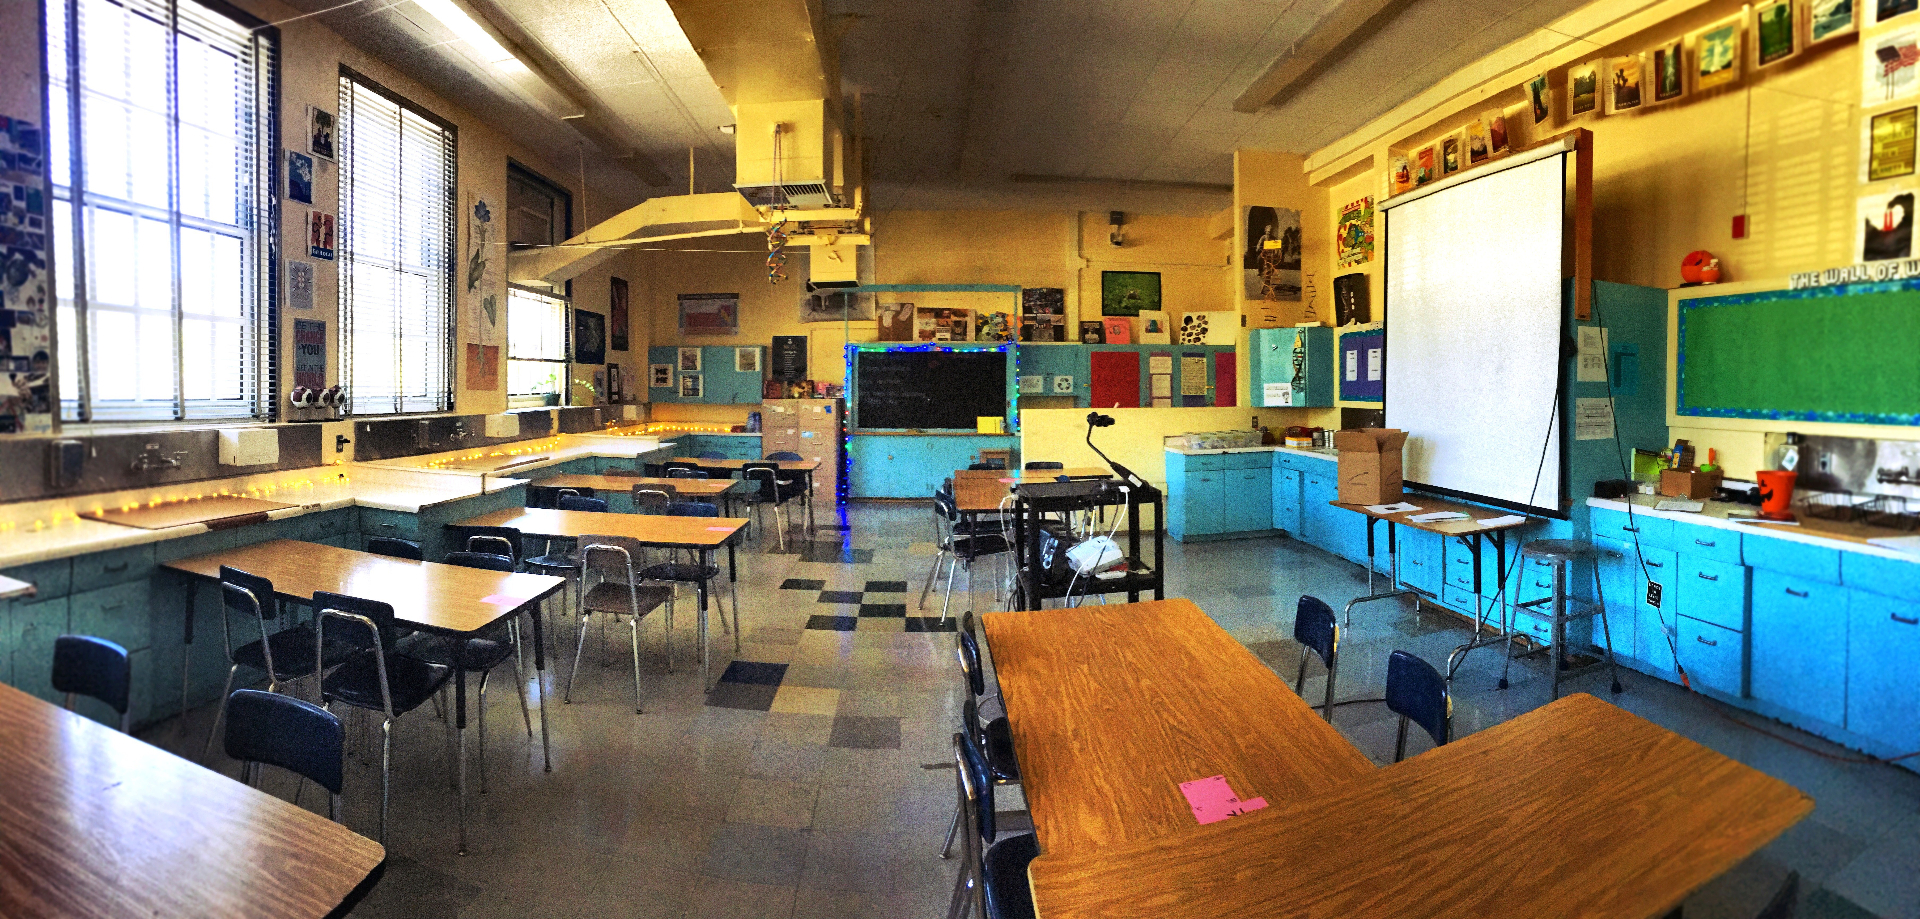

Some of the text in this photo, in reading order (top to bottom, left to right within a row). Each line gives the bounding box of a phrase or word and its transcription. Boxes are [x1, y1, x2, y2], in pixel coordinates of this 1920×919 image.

[1790, 271, 1820, 289] THE
[1824, 264, 1869, 286] WALL
[1877, 262, 1899, 281] OF
[301, 343, 320, 355] YOU
